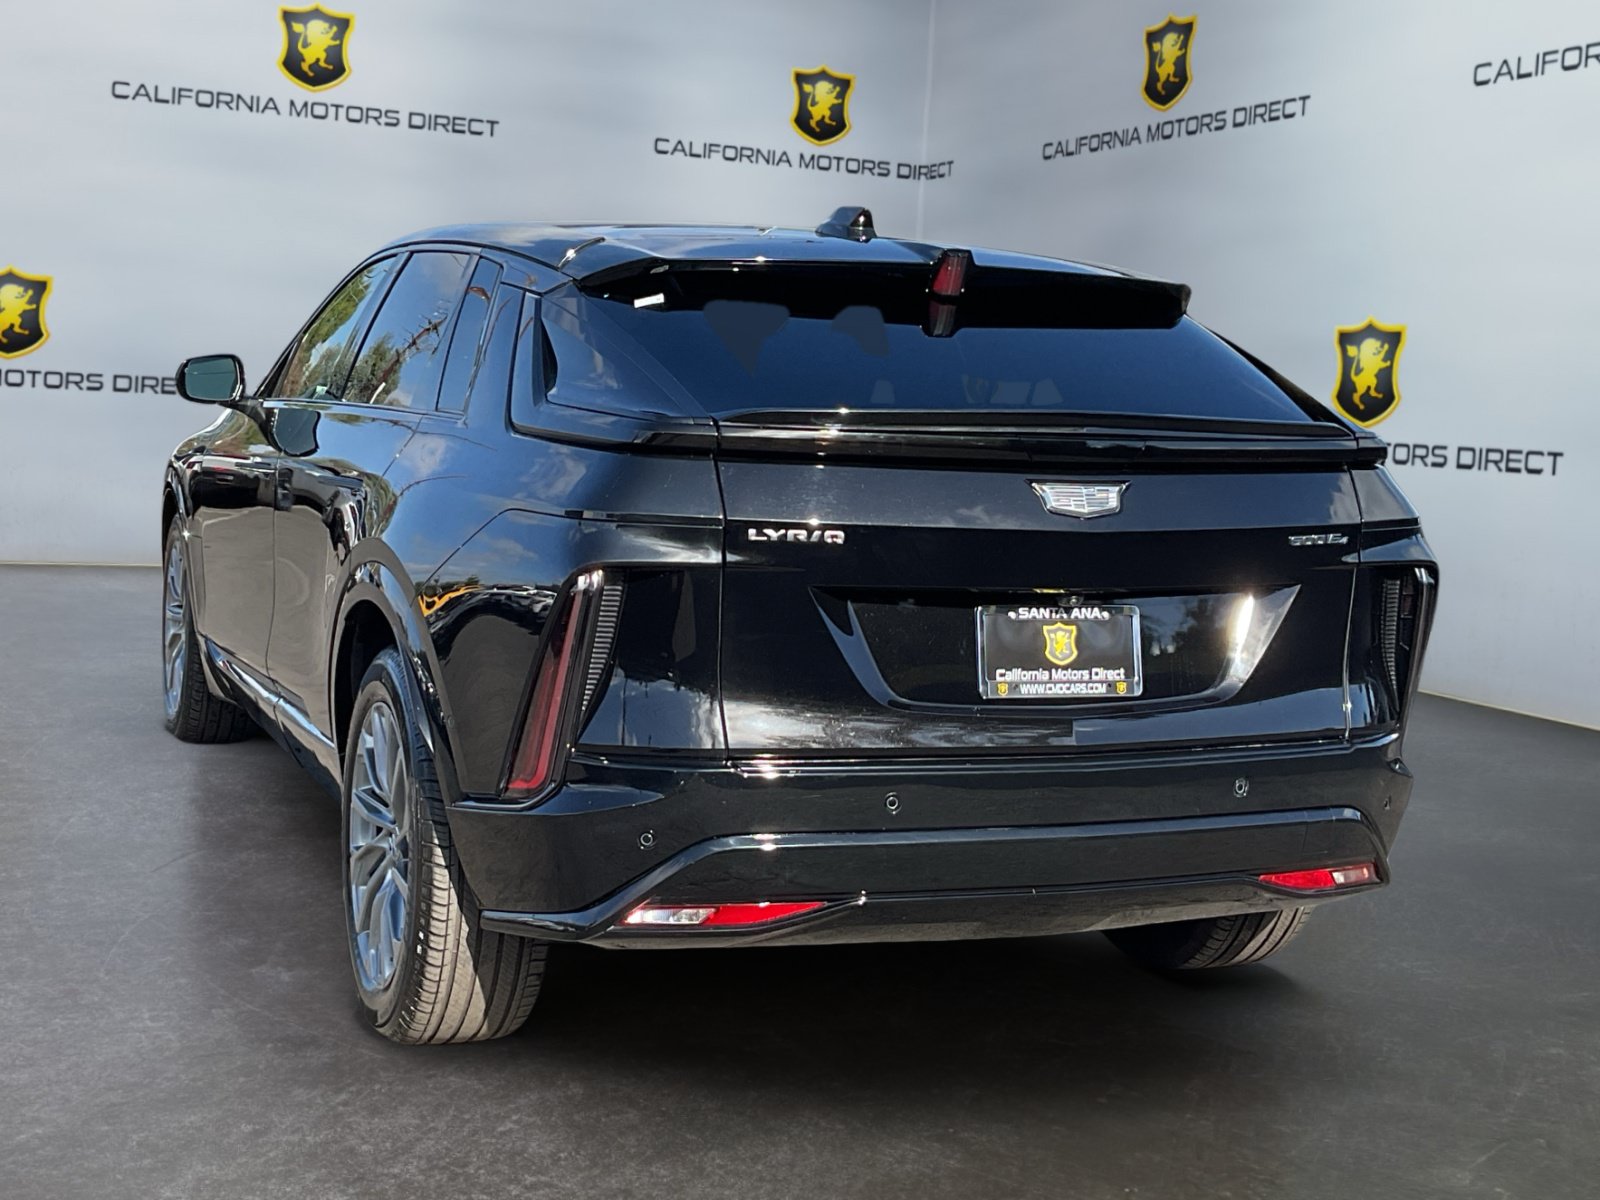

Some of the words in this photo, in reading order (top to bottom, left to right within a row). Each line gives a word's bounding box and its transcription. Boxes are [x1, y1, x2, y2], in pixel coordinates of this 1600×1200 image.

[111, 81, 280, 115] CALIFORNIA
[289, 99, 400, 127] MOTORS
[407, 111, 500, 137] DIRECT
[1042, 126, 1142, 161] CALIFORNIA
[1146, 110, 1227, 144] MOTORS
[1232, 95, 1311, 128] DIRECT
[654, 137, 792, 168] CALIFORNIA
[799, 153, 891, 177] MOTORS
[896, 160, 954, 182] DIRECT
[0, 368, 104, 392] OTORS
[1387, 442, 1448, 468] ORS
[1456, 446, 1564, 476] DIRECT
[747, 528, 845, 545] LYRIQ
[1018, 607, 1068, 620] SANTA
[1070, 607, 1101, 619] ANA
[995, 667, 1049, 681] California
[1051, 667, 1090, 680] Motors
[1091, 667, 1125, 680] Direct
[1019, 683, 1107, 695] WWW.CMDCARS.COM
